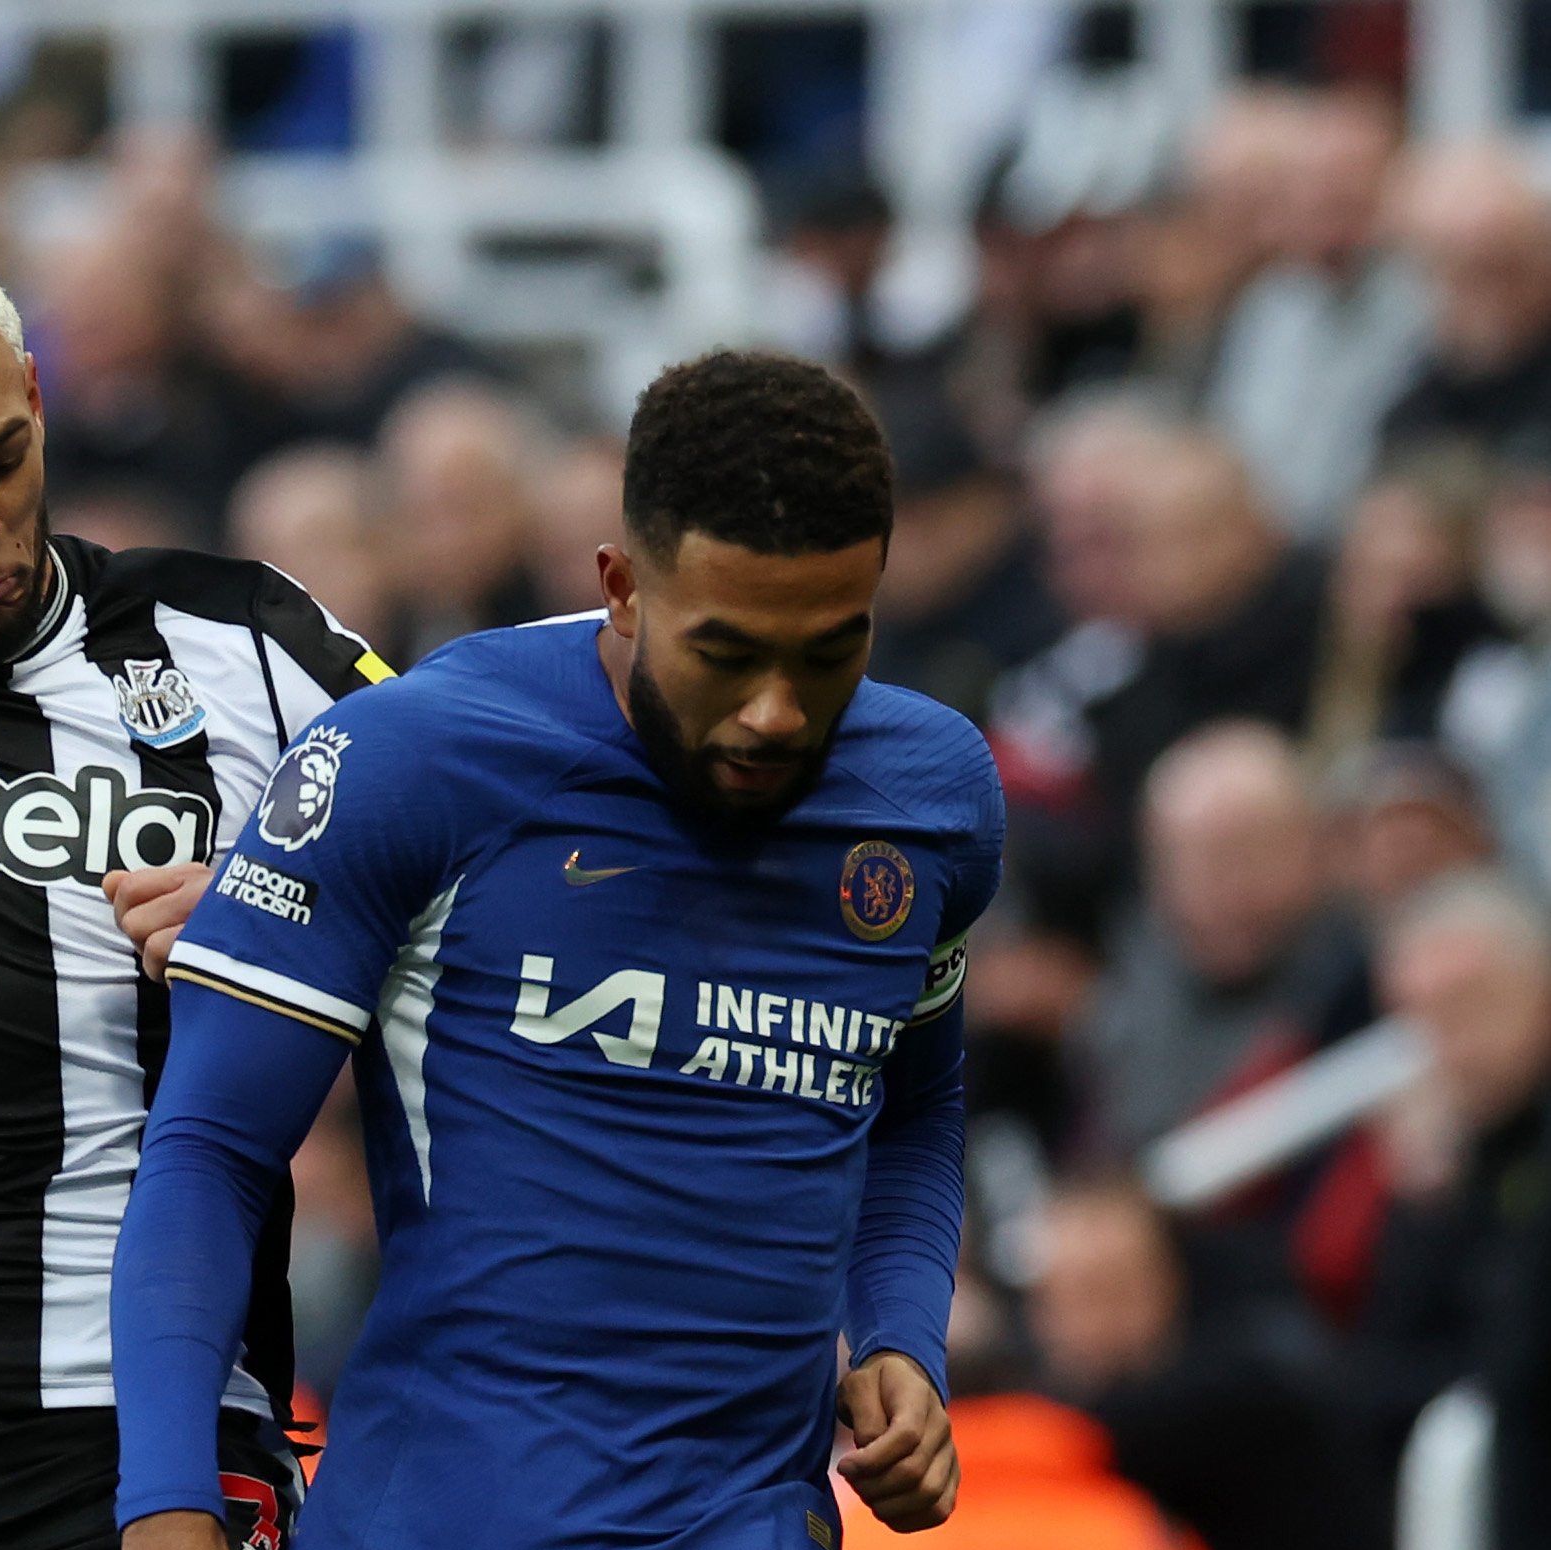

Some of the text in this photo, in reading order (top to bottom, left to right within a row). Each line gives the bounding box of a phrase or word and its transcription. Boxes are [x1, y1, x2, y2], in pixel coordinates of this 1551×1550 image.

[235, 882, 311, 925] racism
[245, 863, 306, 902] room
[678, 1036, 882, 1107] ATHLETE
